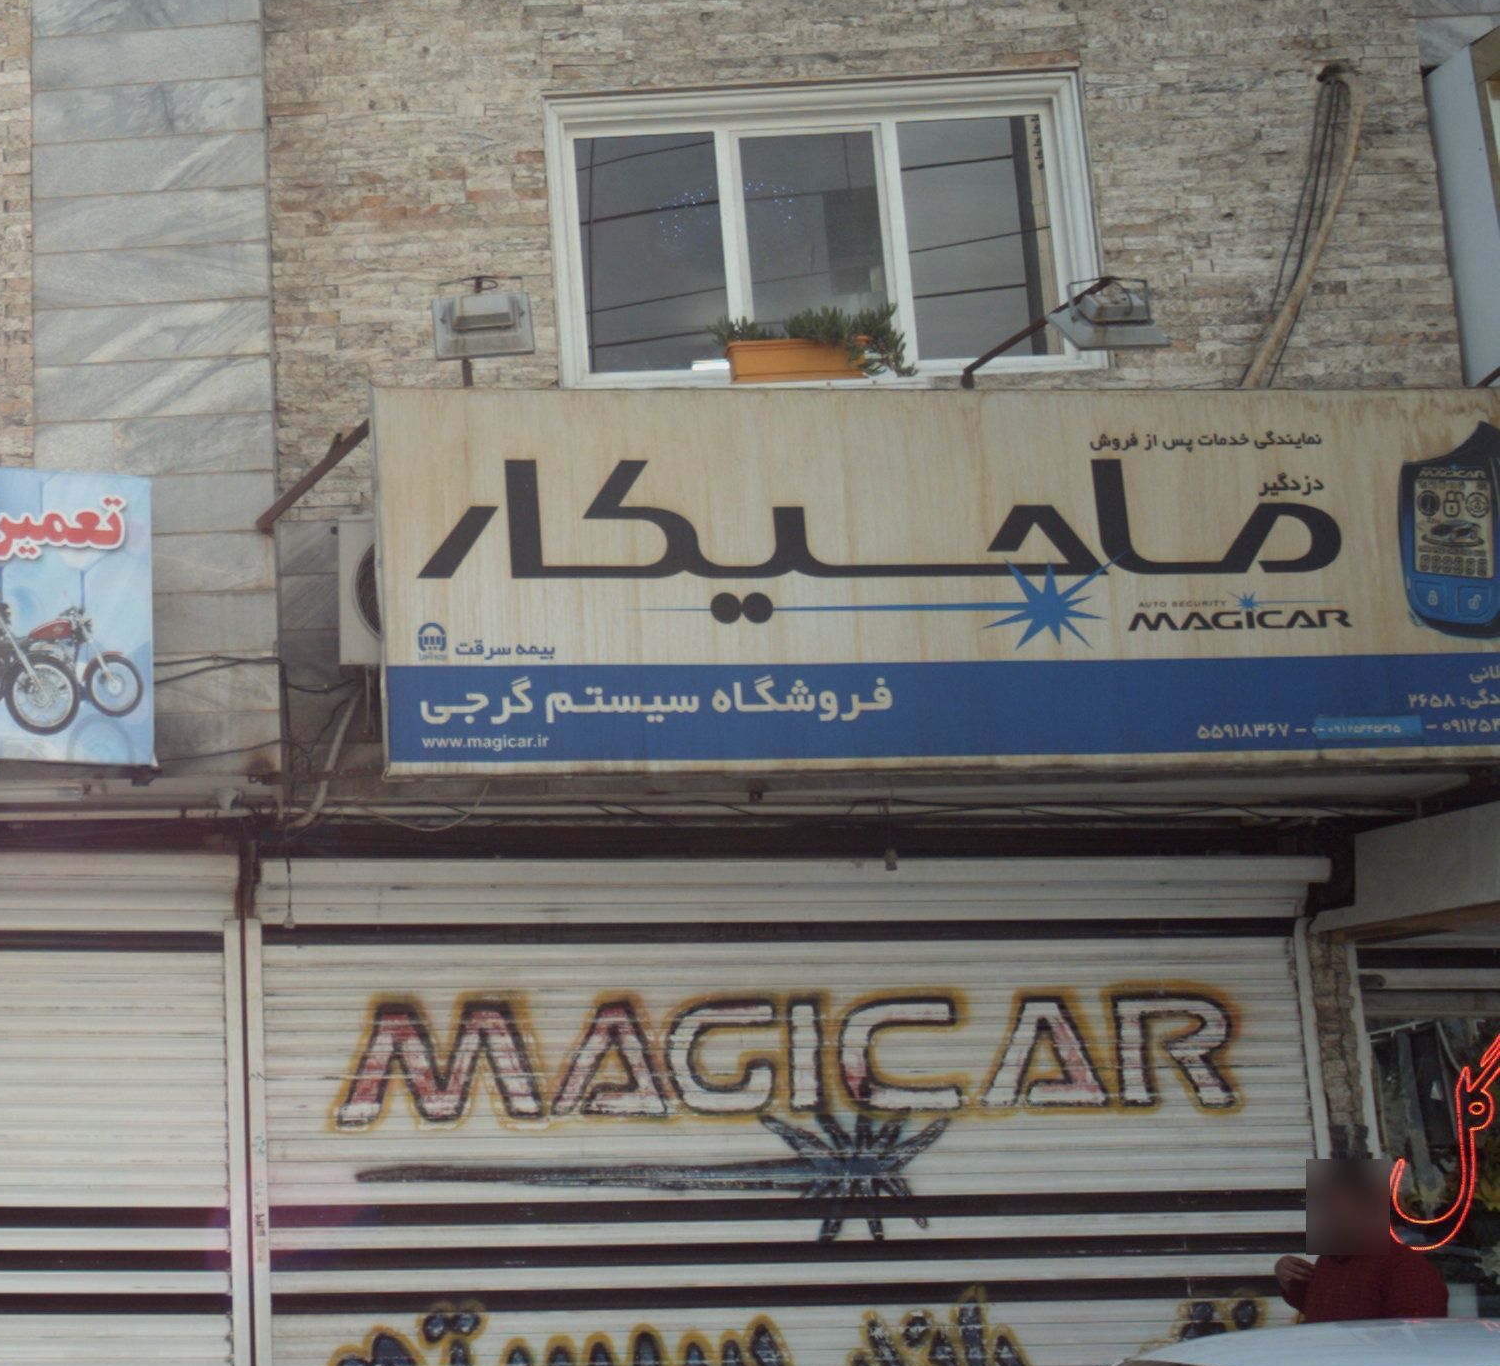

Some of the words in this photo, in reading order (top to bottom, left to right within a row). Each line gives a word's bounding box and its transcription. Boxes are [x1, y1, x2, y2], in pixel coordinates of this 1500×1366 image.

[1089, 431, 1138, 451] فروش
[1143, 433, 1158, 451] از
[1162, 436, 1193, 453] پس
[1197, 433, 1249, 447] خدمات
[1253, 430, 1322, 450] نمایندگی
[1258, 472, 1324, 496] دزدگیر
[1128, 609, 1353, 632] MAGICAR
[455, 639, 512, 661] سرقت
[515, 643, 556, 660] بیمه
[419, 675, 534, 725] گرجی
[545, 685, 700, 723] سیستم
[711, 676, 894, 722] فروشگاه
[1407, 693, 1457, 708] ۲۶۵۸
[1196, 722, 1291, 740] ۵۵۹۱۸۳۶۷
[421, 734, 549, 752] www.magicar.ir
[334, 990, 1240, 1128] MAGICAR
